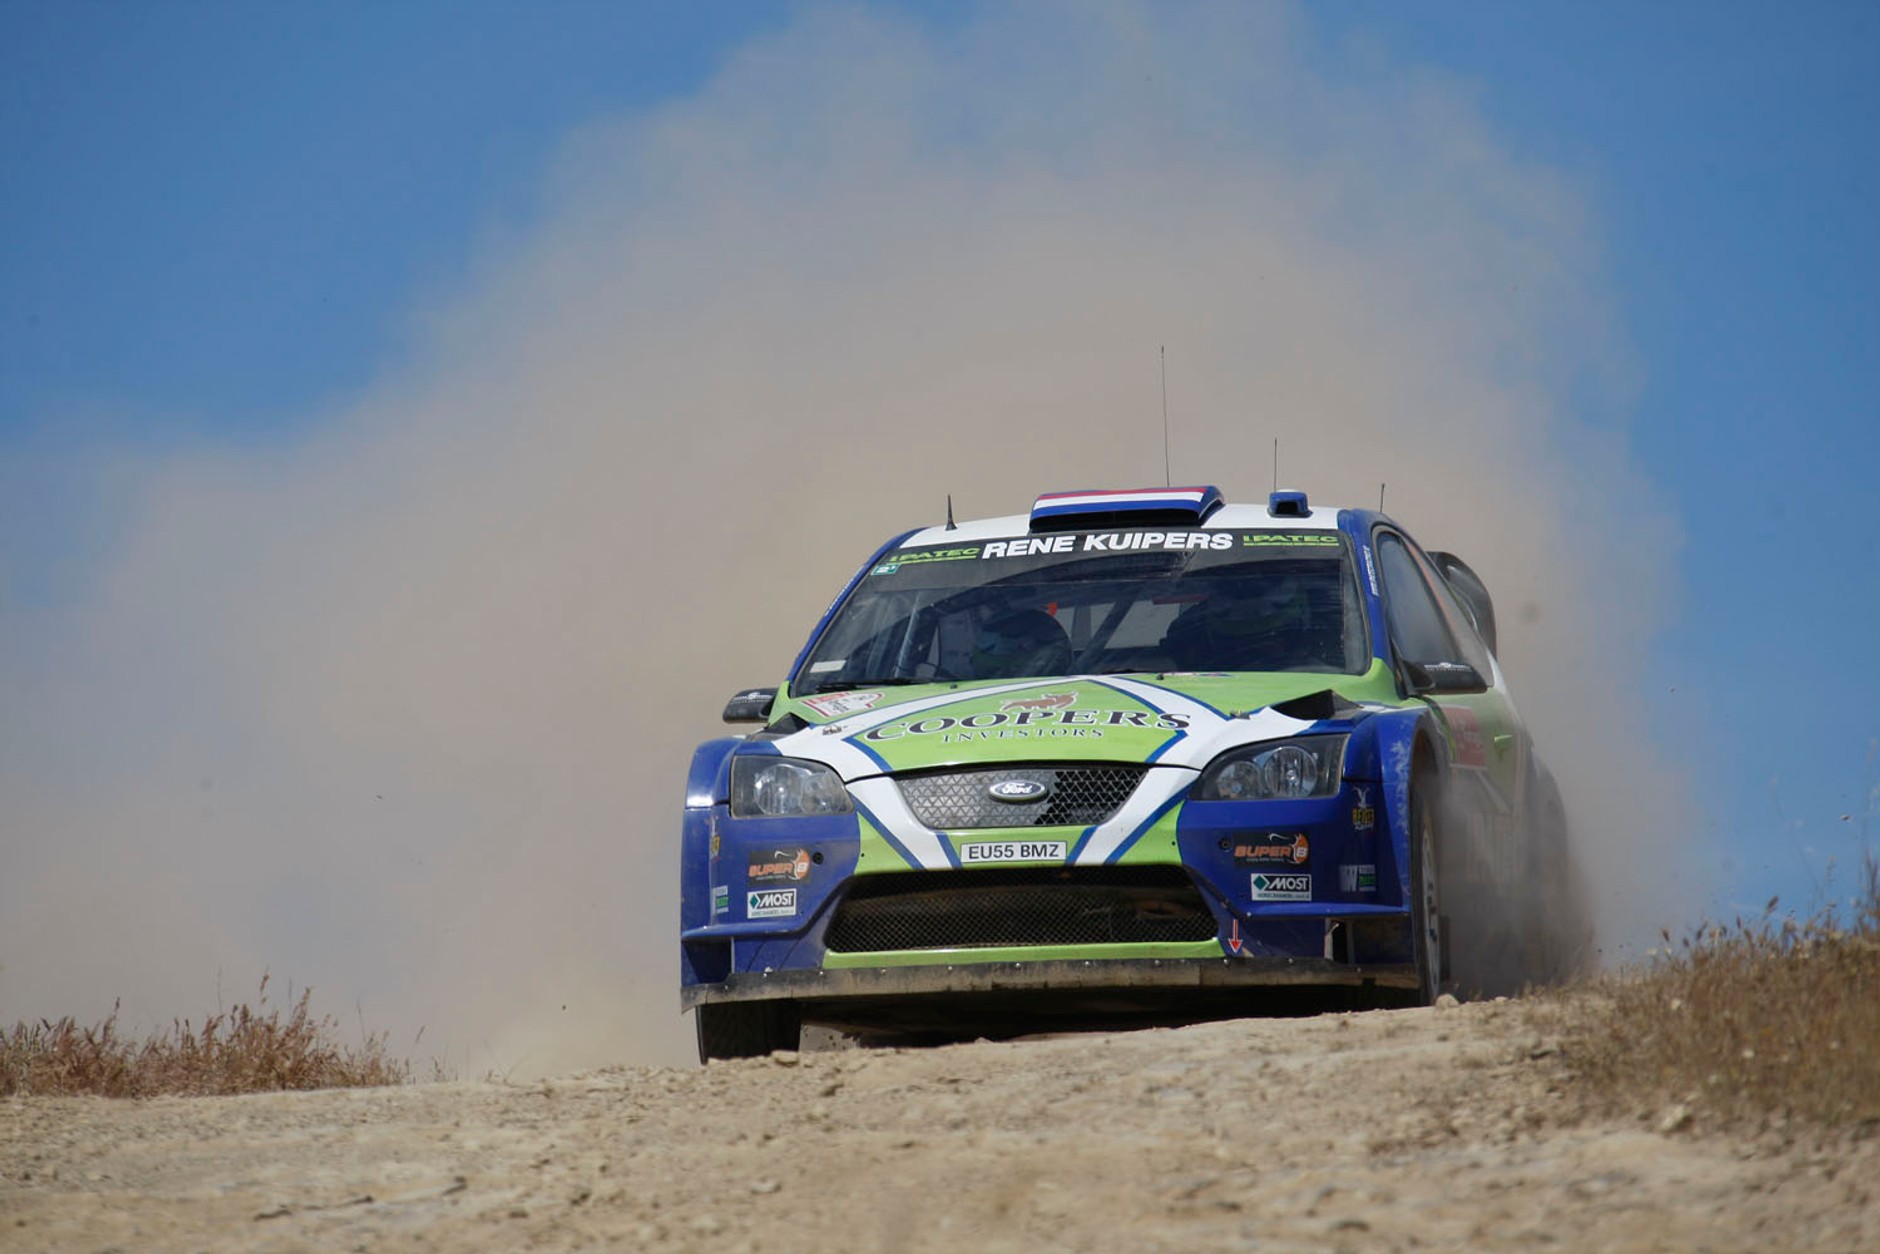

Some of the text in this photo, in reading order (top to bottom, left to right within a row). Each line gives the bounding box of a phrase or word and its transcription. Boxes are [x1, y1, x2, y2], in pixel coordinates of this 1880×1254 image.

[981, 532, 1234, 560] RENE KUIPERS
[864, 709, 1192, 742] COOPERS
[943, 728, 1105, 743] INVESTORS
[1001, 782, 1033, 794] Ford
[968, 844, 1060, 860] EU55 BMZ
[1268, 876, 1309, 891] MOST
[759, 892, 794, 908] MOST
